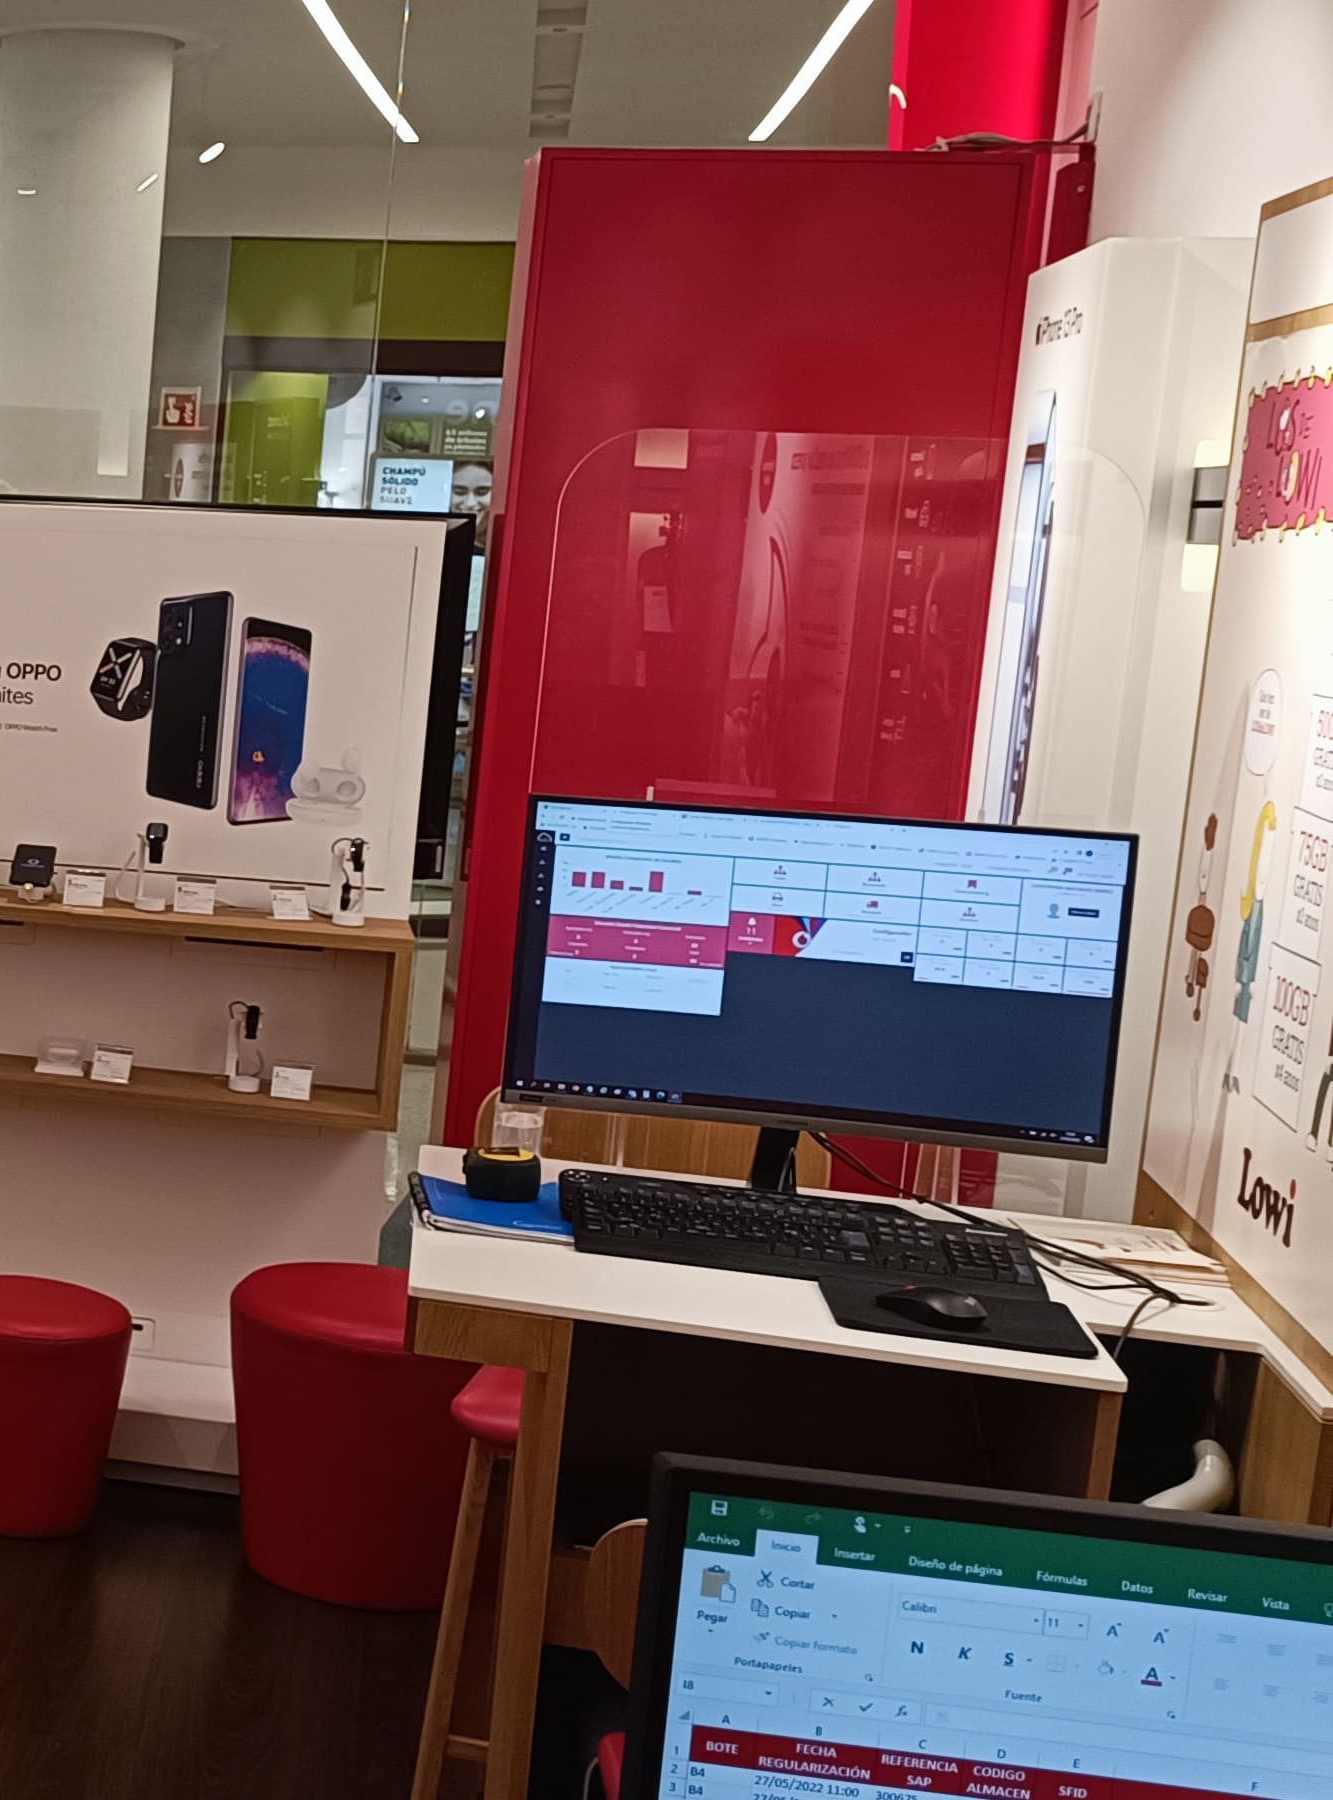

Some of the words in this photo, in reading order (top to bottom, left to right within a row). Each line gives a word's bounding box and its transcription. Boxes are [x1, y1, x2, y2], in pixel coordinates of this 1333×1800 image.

[382, 466, 426, 476] CHAMPÚ
[382, 476, 419, 486] SÓLIDO
[380, 486, 407, 495] PELO
[379, 495, 413, 505] SUAVE
[6, 661, 62, 682] OPPO
[1272, 975, 1311, 1027] 100GB
[1238, 1147, 1296, 1248] Lowi
[696, 1531, 741, 1548] Archivo
[771, 1540, 801, 1553] Inicio
[834, 1547, 876, 1562] Insertar
[908, 1554, 946, 1571] Diseño
[948, 1560, 963, 1573] de
[965, 1562, 1003, 1578] página
[1036, 1569, 1088, 1587] Fórmulas
[1121, 1580, 1154, 1594] Datos
[1188, 1588, 1228, 1603] Revisar
[1262, 1597, 1290, 1611] Vista
[781, 1576, 815, 1591] Cortar
[697, 1609, 728, 1625] Pegar
[774, 1605, 811, 1620] Copiar
[901, 1599, 937, 1615] Calibri
[1047, 1616, 1060, 1628] 11
[774, 1635, 811, 1651] Copiar
[812, 1640, 858, 1656] formato
[910, 1640, 924, 1654] N
[958, 1646, 972, 1660] K
[1004, 1653, 1015, 1667] S
[734, 1656, 803, 1674] Portapapeles
[1004, 1689, 1043, 1703] Fuente
[705, 1740, 740, 1755] BOTE
[721, 1714, 731, 1725] A
[815, 1726, 823, 1736] B
[917, 1738, 927, 1750] C
[997, 1748, 1007, 1760] D
[1072, 1758, 1081, 1769] E
[1251, 1781, 1260, 1792] F
[796, 1743, 838, 1759] FECHA
[758, 1755, 871, 1780] REGULARIZACIÓN
[880, 1753, 959, 1774] REFERENCIA
[670, 1763, 678, 1774] 2
[690, 1766, 706, 1778] B4
[754, 1774, 824, 1794] 27/05/2022
[826, 1784, 860, 1799] 11:00
[906, 1774, 932, 1788] SAP
[972, 1765, 1026, 1782] CODIGO
[668, 1781, 676, 1792] 3
[688, 1784, 703, 1796] B4
[966, 1782, 1031, 1800] ALMACEN
[1058, 1785, 1088, 1799] SFID
